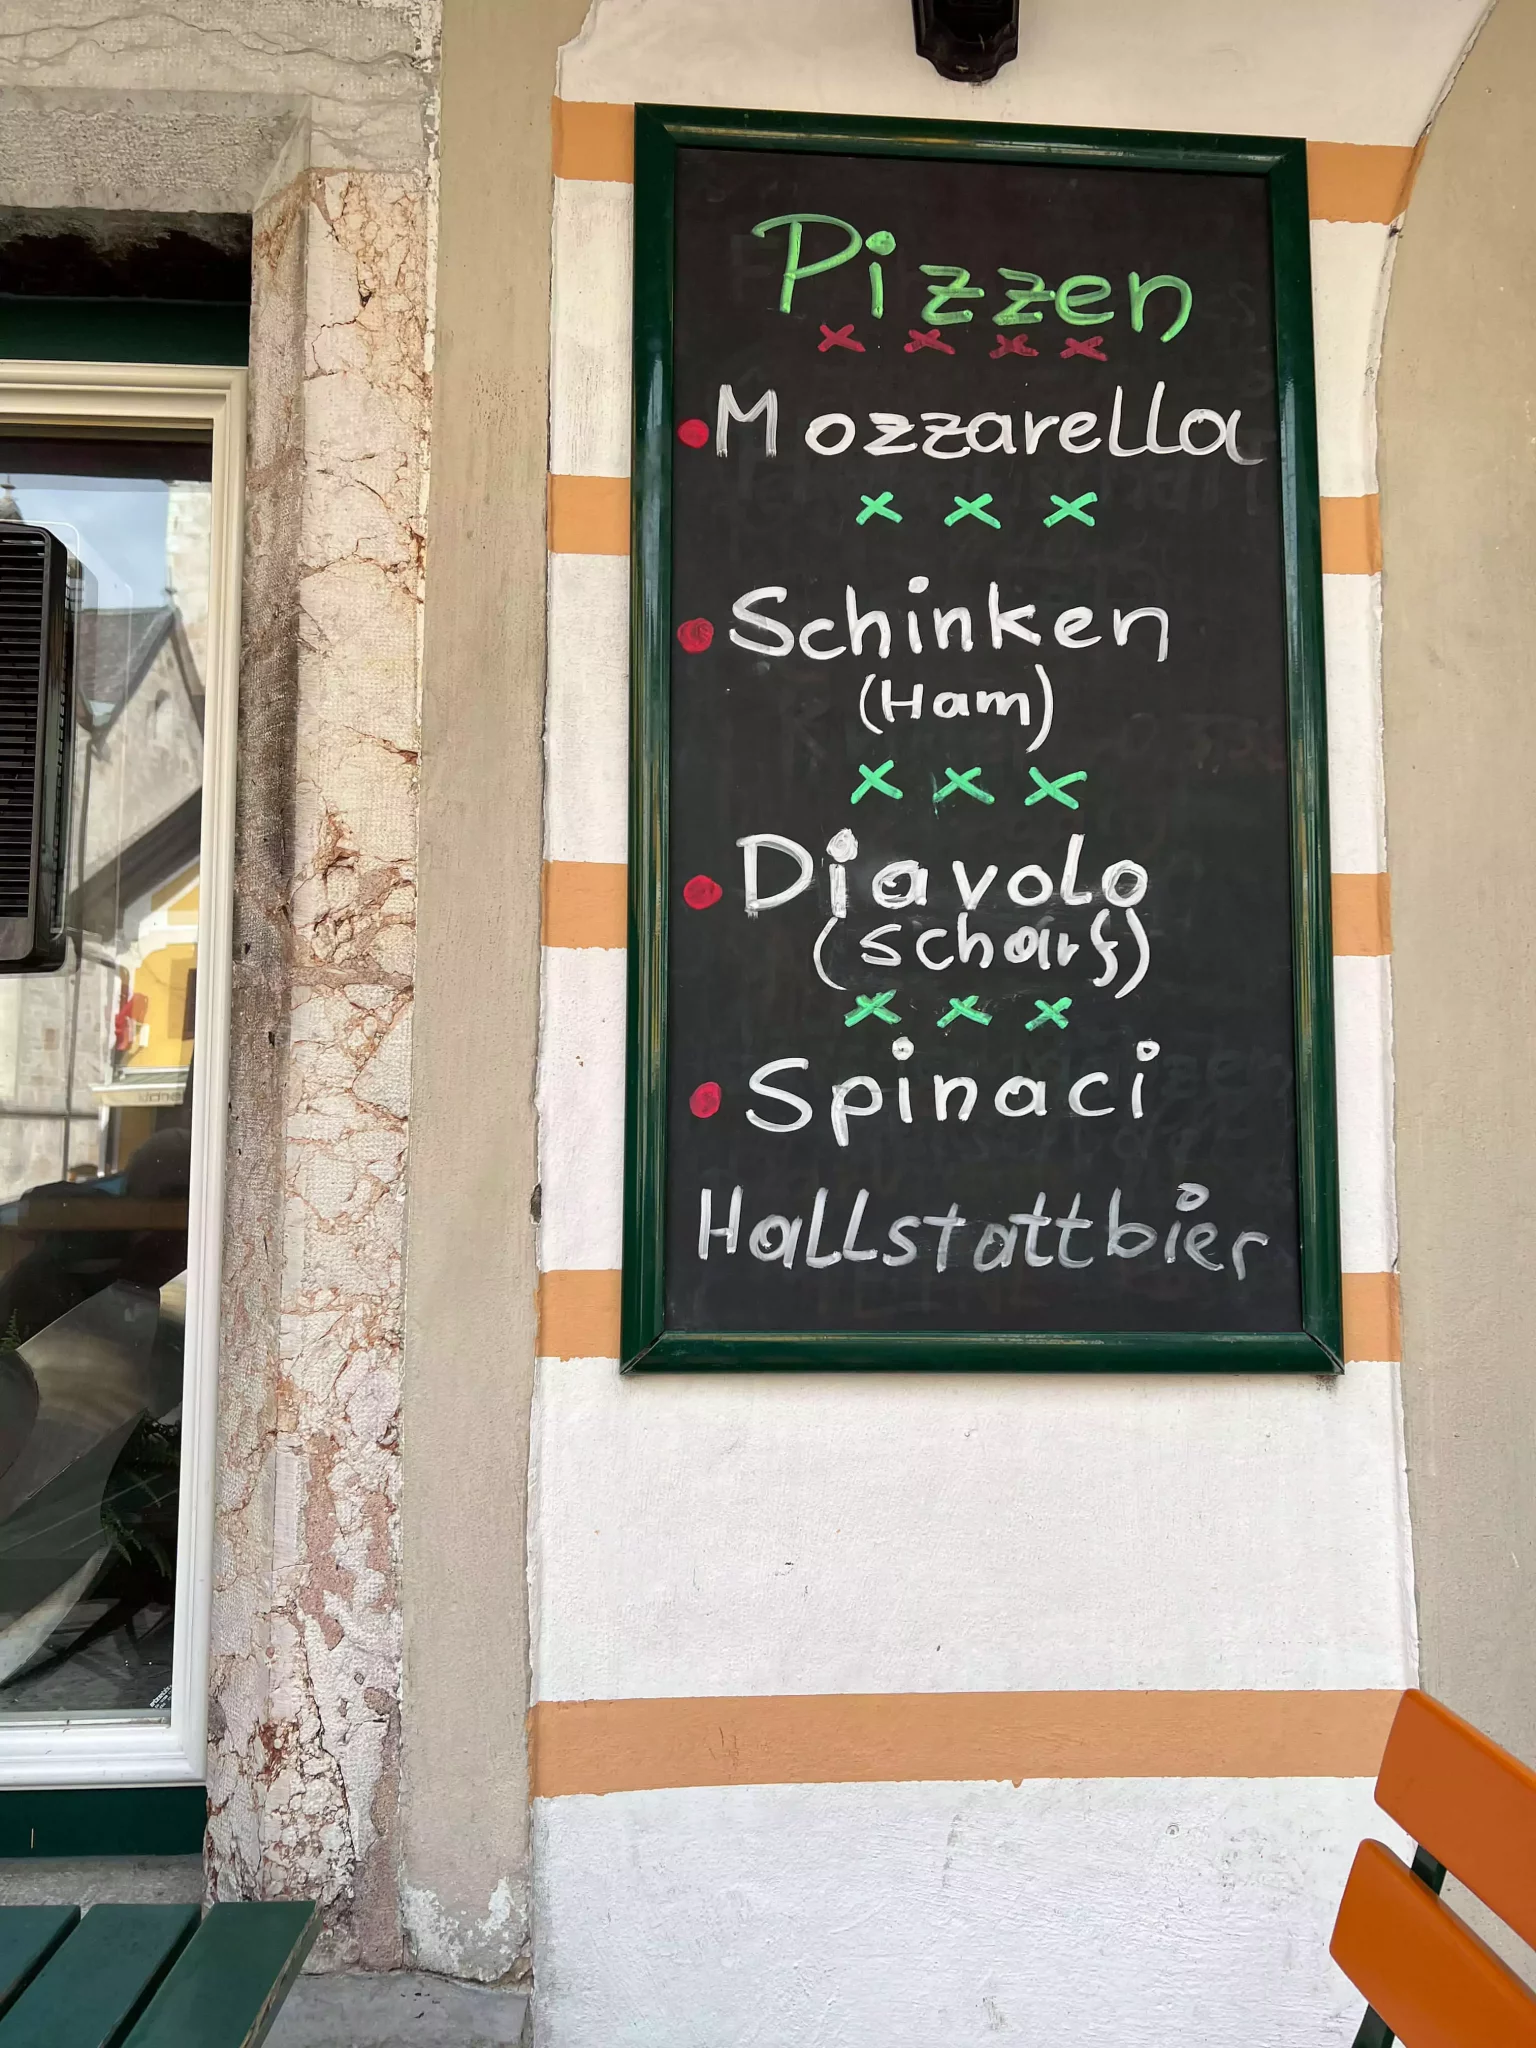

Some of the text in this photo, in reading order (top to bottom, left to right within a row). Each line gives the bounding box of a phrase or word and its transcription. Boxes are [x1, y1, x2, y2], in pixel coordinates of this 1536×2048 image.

[751, 214, 1192, 342] Pizzen
[716, 381, 1263, 465] Mozzarella
[729, 576, 1168, 662] Schinken
[860, 664, 1053, 752] (Ham)
[736, 828, 1148, 918] Diavolo
[746, 1036, 1160, 1147] Spinaci
[698, 1183, 1268, 1280] Hallstattbier
